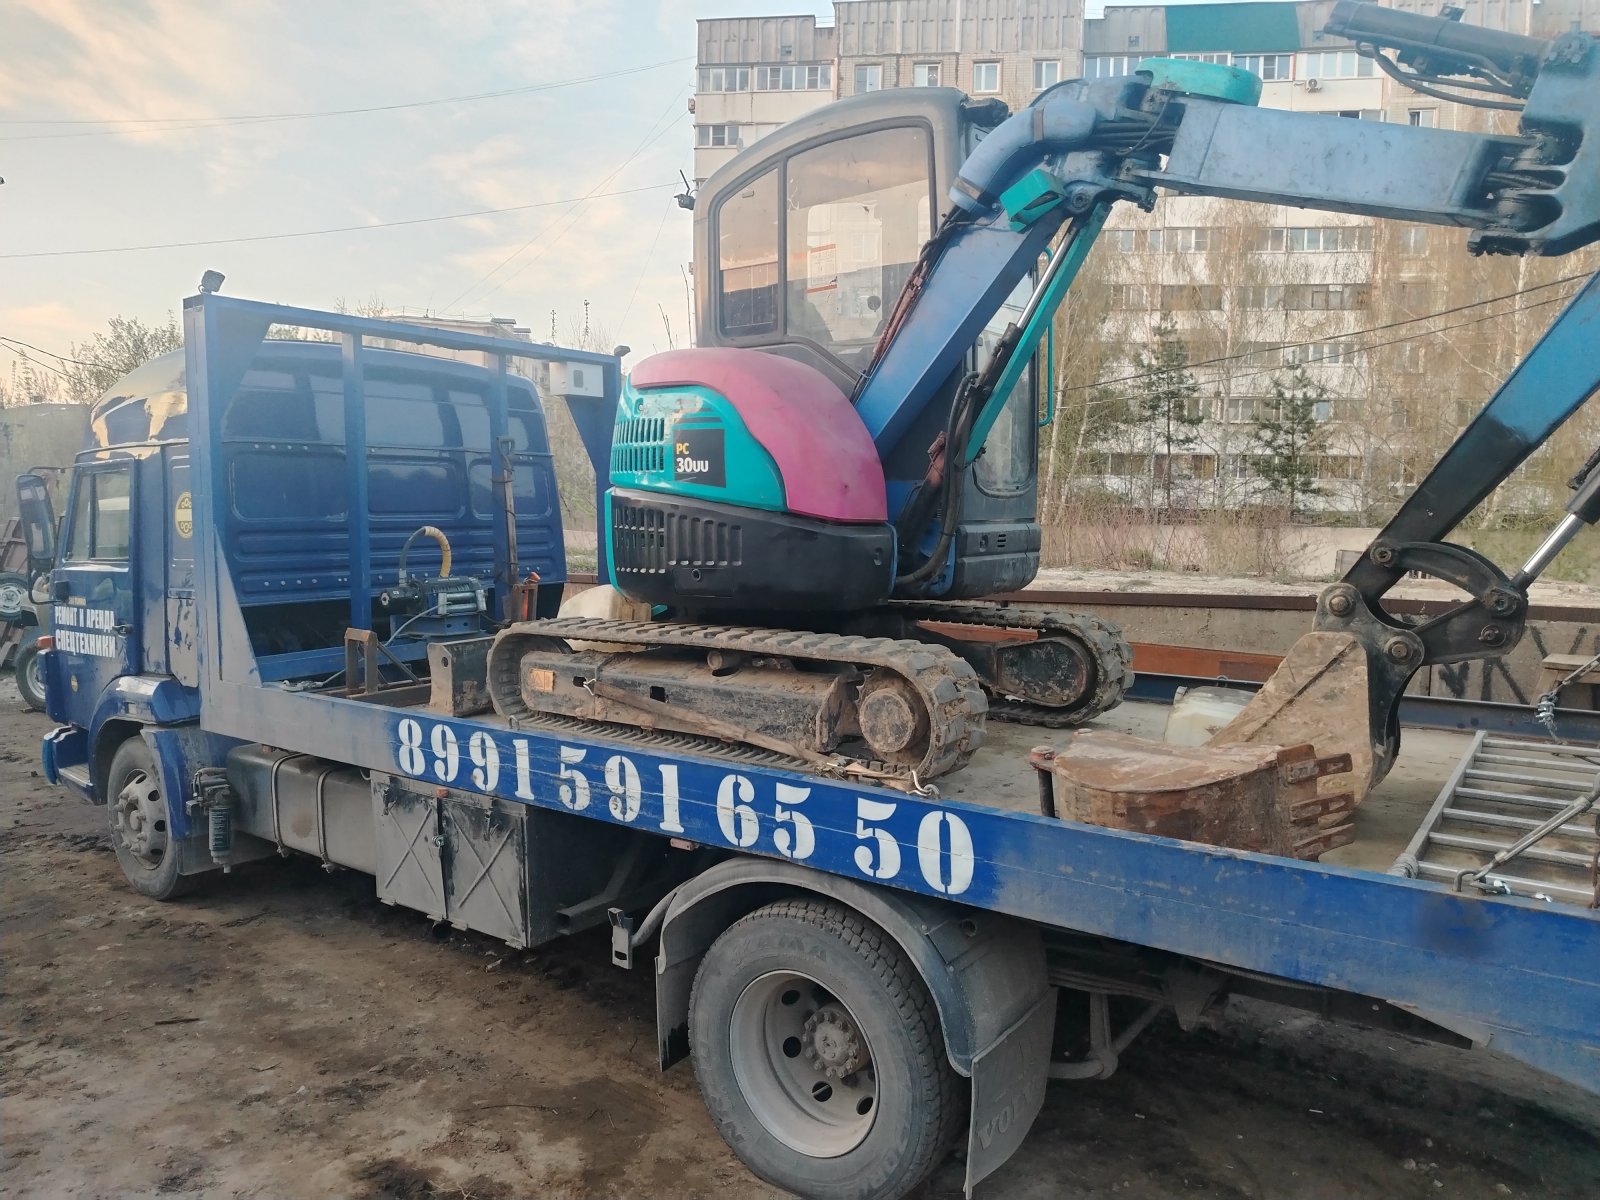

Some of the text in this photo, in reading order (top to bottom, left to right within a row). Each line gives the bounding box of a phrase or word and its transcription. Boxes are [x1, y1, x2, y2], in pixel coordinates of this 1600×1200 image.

[677, 443, 690, 454] PC
[55, 606, 77, 626] РЕМОНТ
[86, 608, 115, 633] АРЕНДА
[56, 629, 116, 658] СПЕЦТЕХНИКИ
